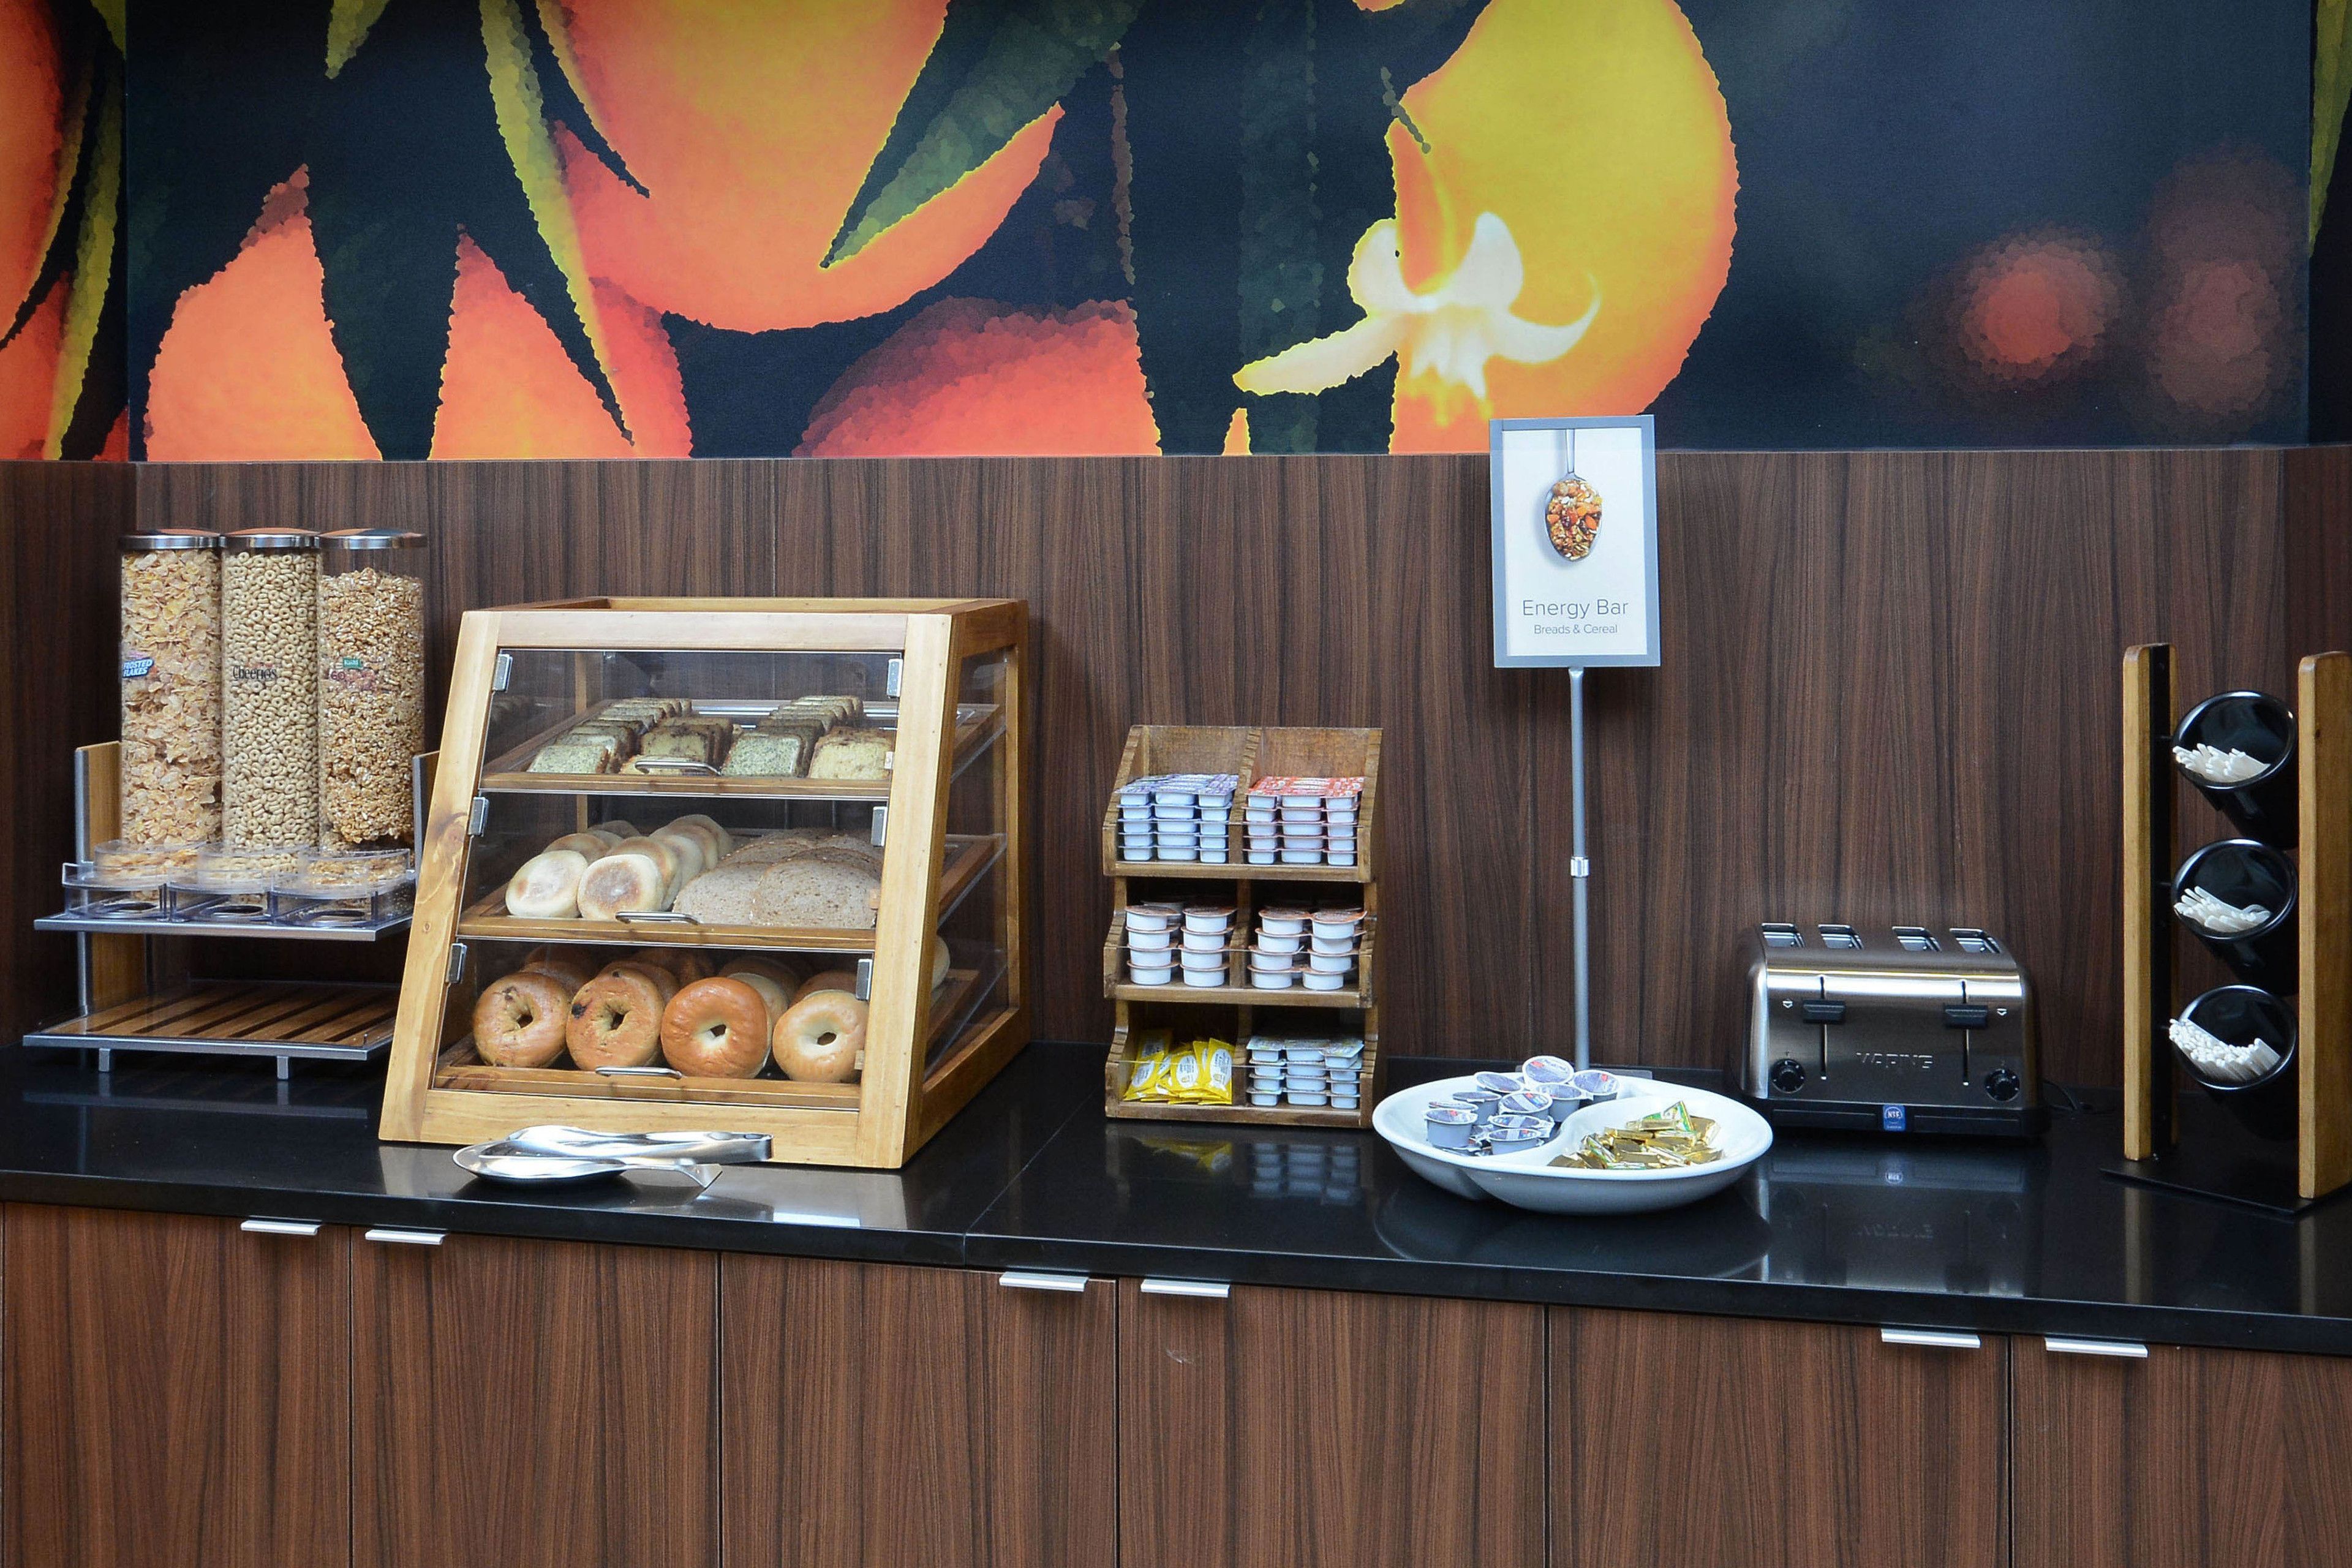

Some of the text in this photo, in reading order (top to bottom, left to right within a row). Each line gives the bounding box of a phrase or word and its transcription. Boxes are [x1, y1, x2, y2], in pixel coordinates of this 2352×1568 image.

[1523, 599, 1629, 619] Energy Bar
[1534, 624, 1618, 635] Breads & Cereal
[123, 658, 154, 671] FROSTED
[123, 666, 148, 677] FLAKES
[233, 665, 279, 680] Cheerios
